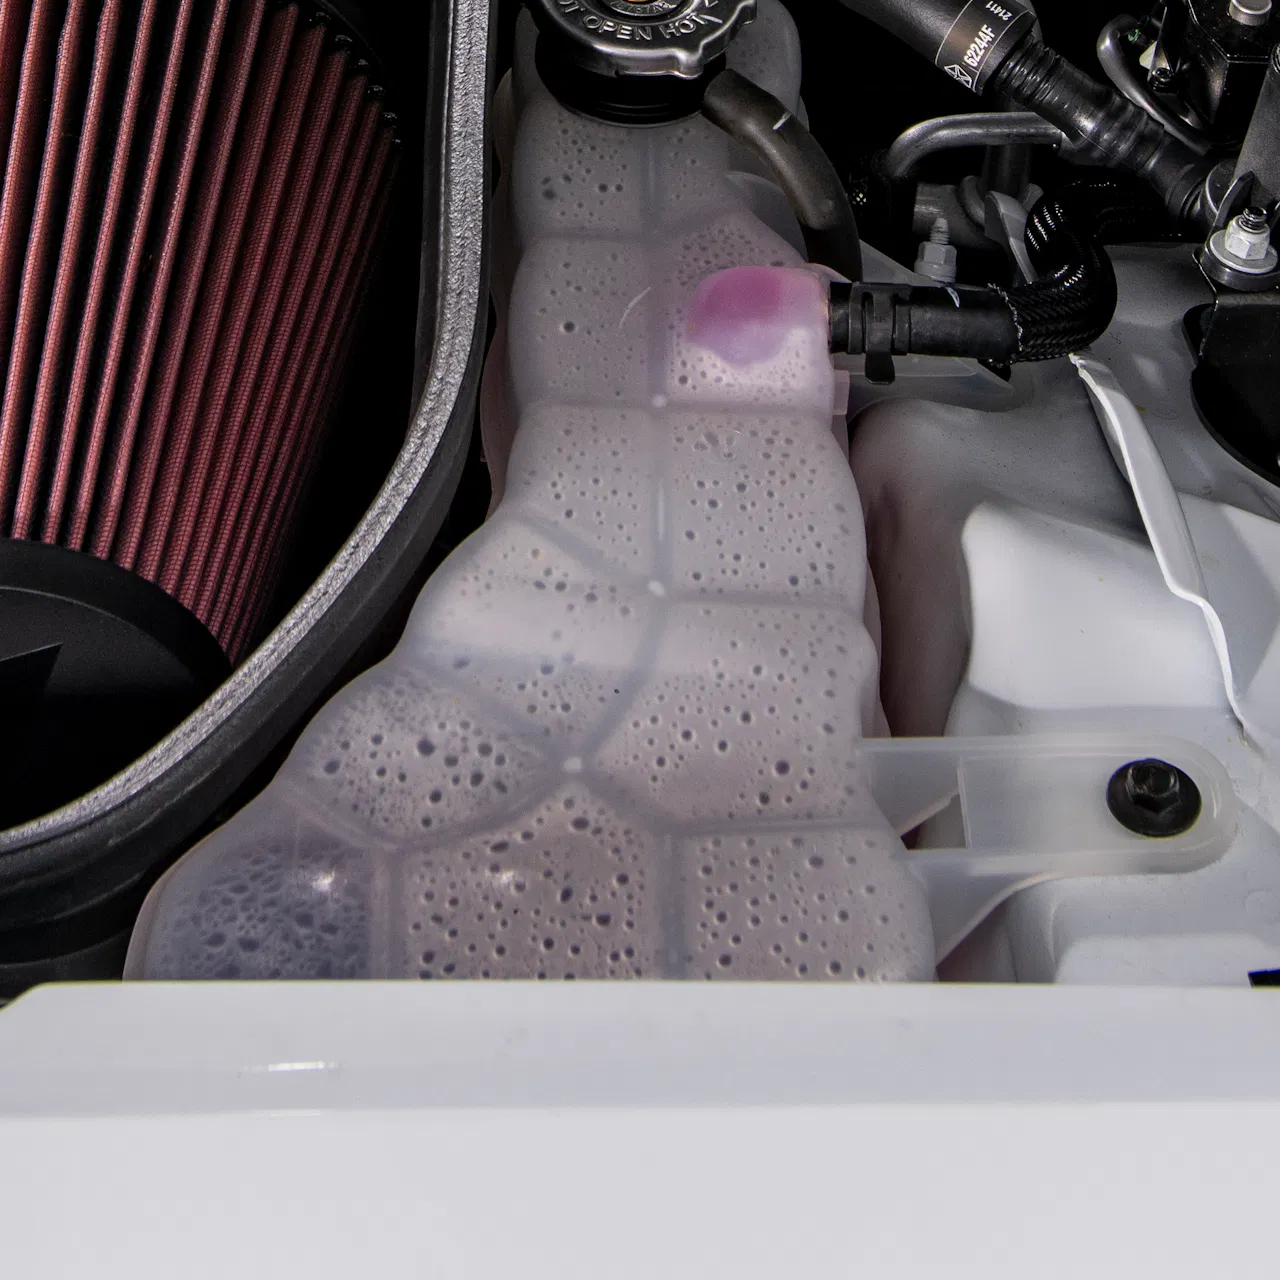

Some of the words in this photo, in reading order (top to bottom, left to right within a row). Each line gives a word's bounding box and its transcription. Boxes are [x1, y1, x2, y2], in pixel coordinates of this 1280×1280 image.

[583, 15, 653, 41] OPEN
[659, 12, 708, 39] HOT
[963, 24, 996, 68] 62244F
